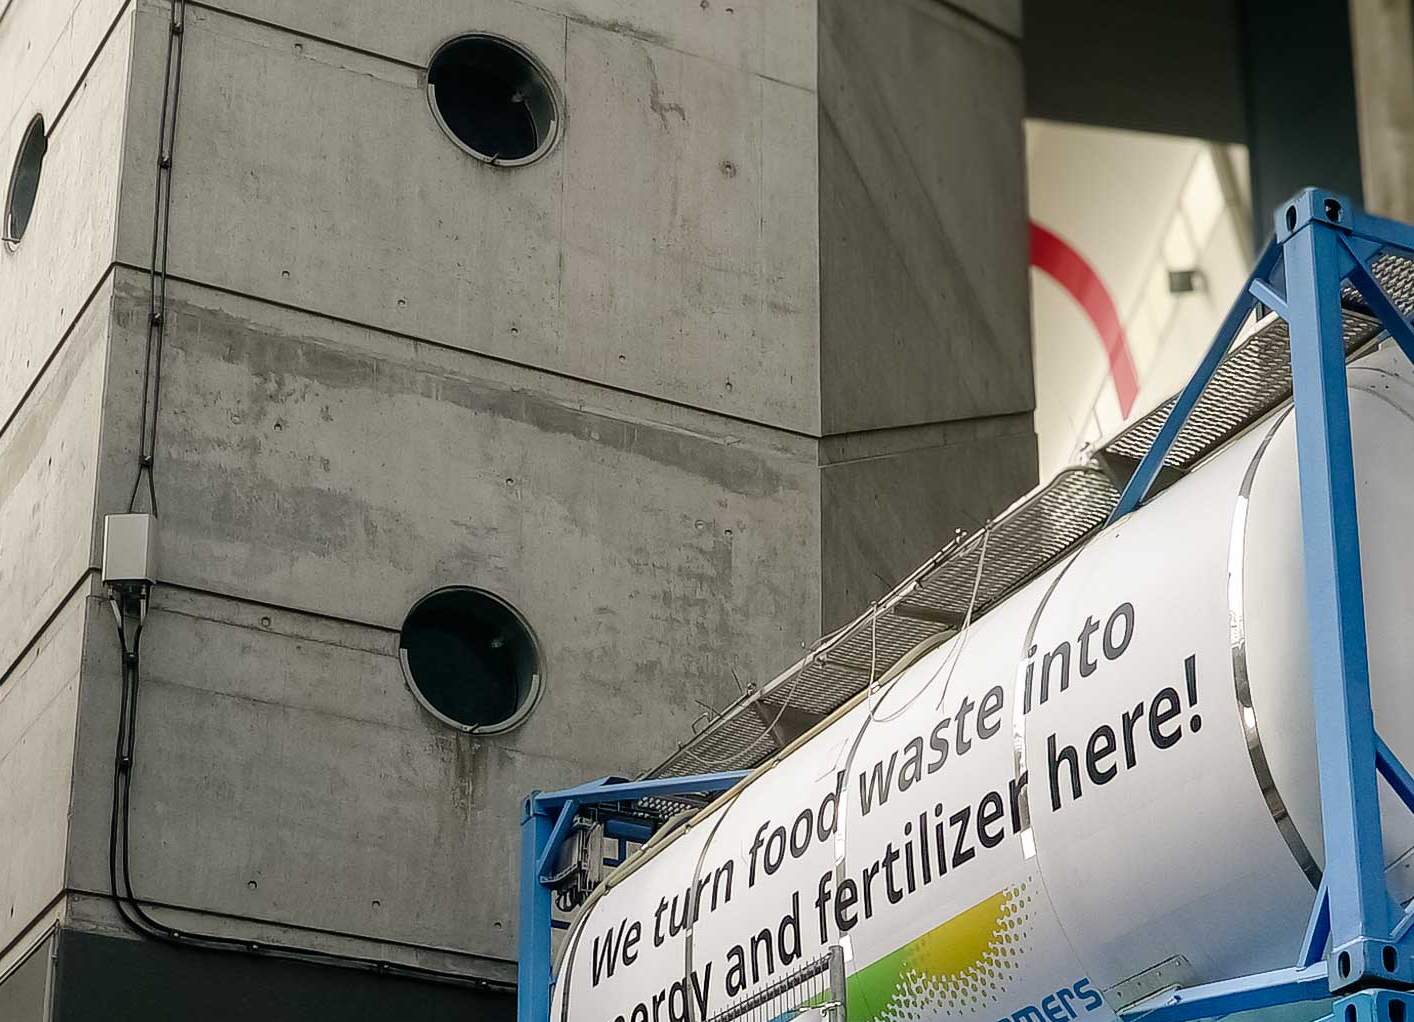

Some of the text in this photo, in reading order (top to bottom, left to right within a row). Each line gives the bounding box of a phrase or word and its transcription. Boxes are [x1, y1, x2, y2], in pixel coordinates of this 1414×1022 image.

[591, 601, 1134, 987] We turn food waste into
[725, 909, 800, 1000] and
[815, 767, 1028, 947] fertilizer
[1047, 655, 1202, 811] here!
